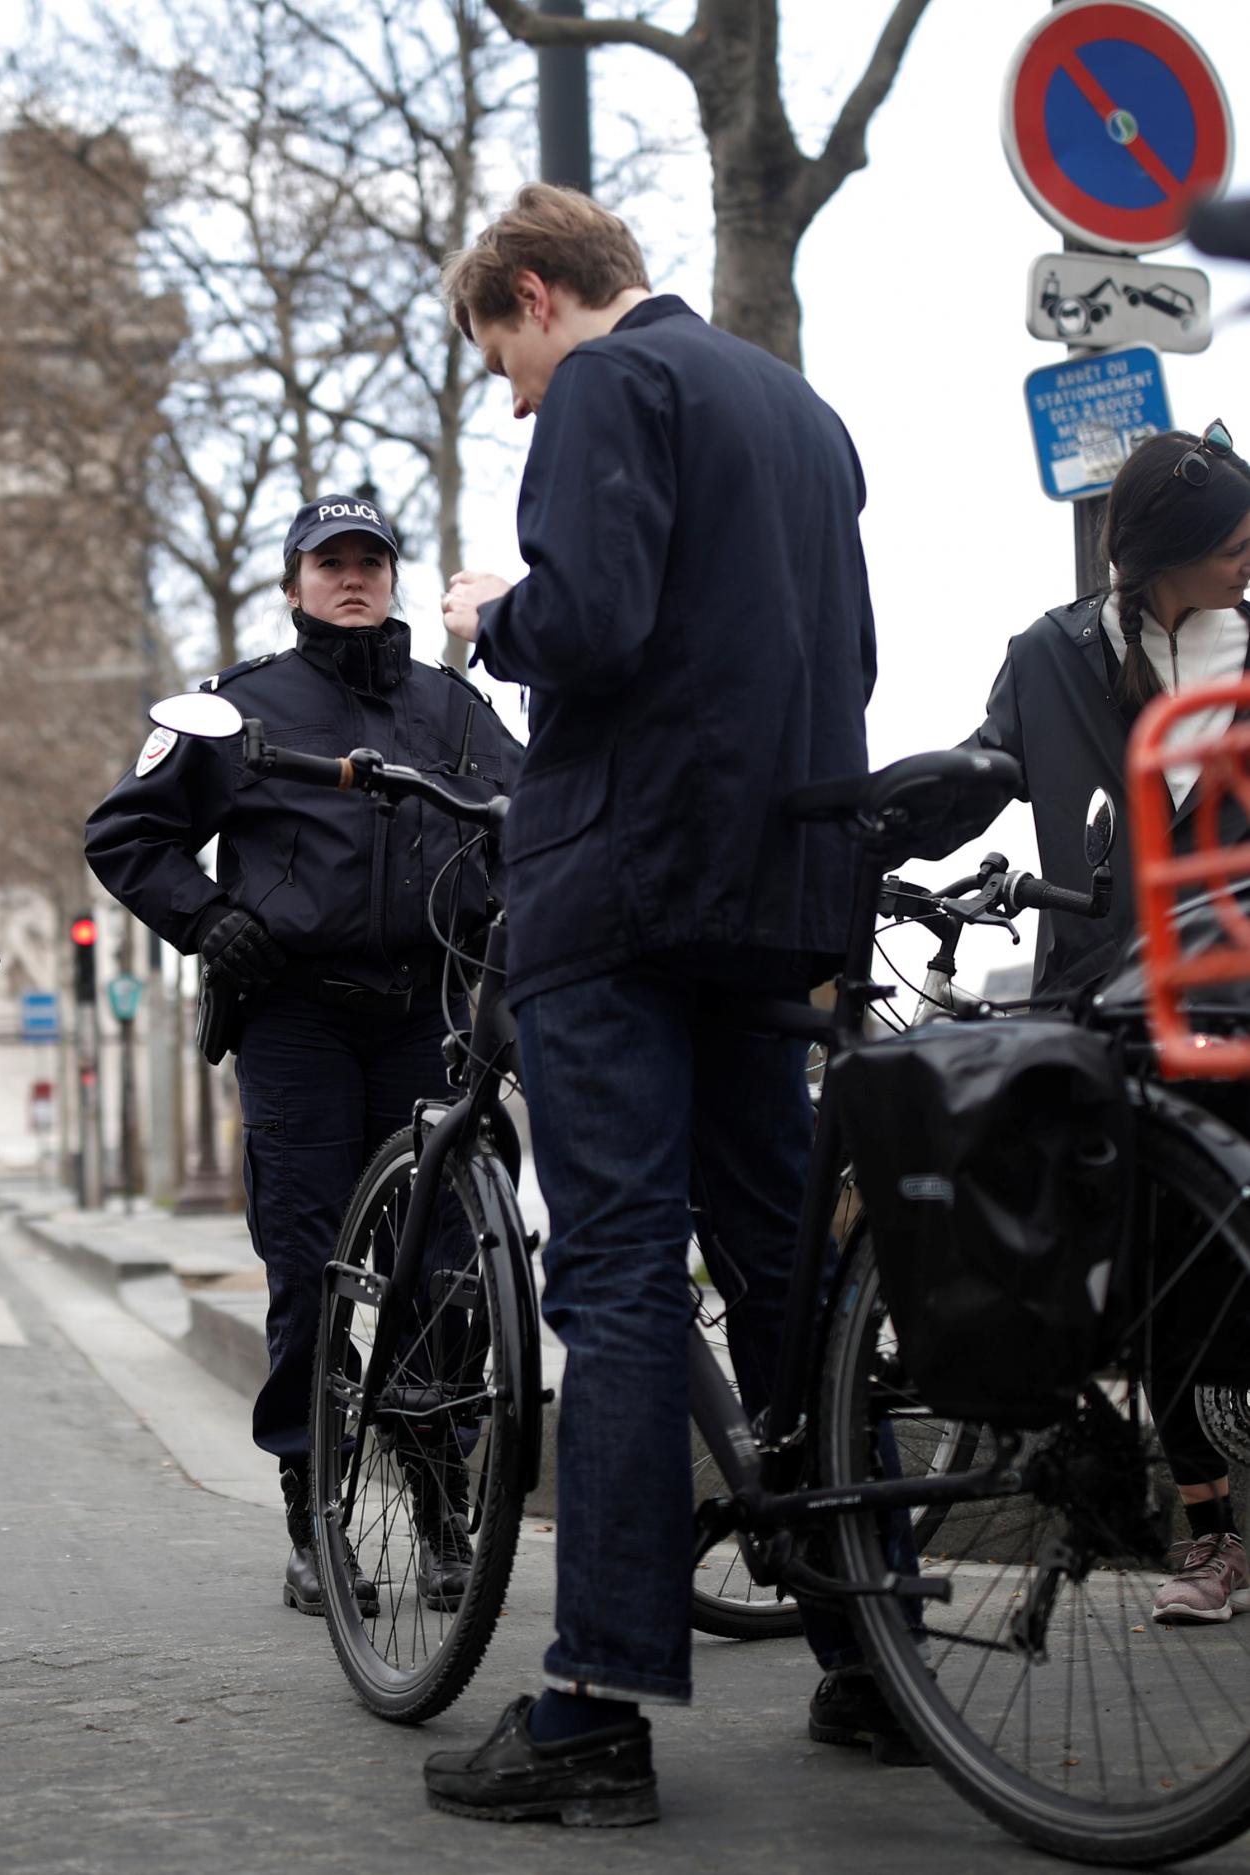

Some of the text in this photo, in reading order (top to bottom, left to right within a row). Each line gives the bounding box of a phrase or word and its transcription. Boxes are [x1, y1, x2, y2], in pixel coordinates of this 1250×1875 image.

[1107, 359, 1128, 377] OU
[1035, 369, 1153, 411] STATIONNEMENT
[319, 504, 381, 526] POLICE
